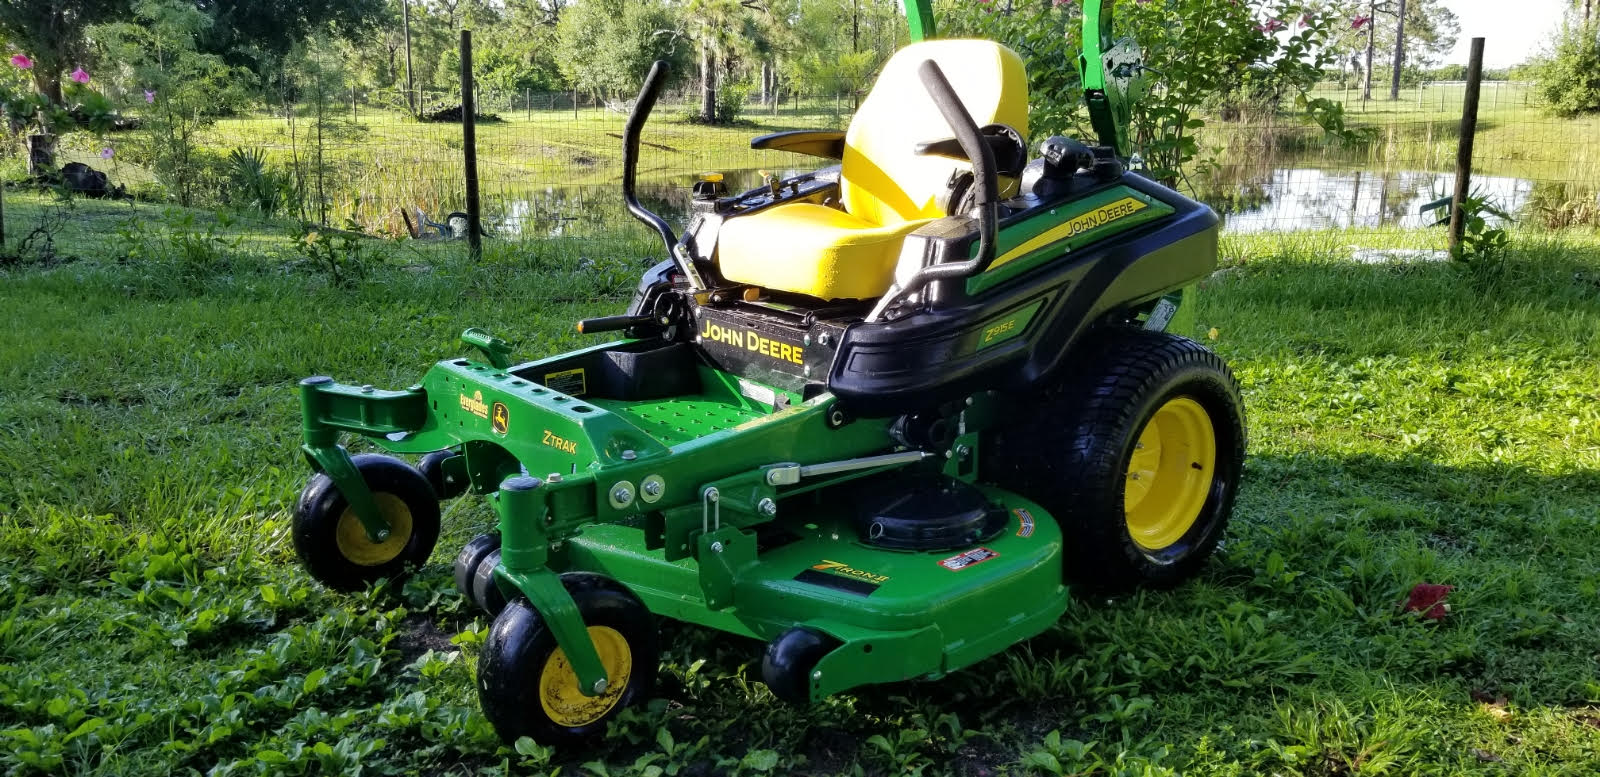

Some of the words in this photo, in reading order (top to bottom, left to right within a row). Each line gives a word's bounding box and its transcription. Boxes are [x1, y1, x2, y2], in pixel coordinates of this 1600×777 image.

[1067, 215, 1098, 236] JOHN
[1098, 201, 1134, 222] DEERE
[702, 320, 743, 348] JOHN
[747, 331, 804, 364] DEERE
[985, 319, 1016, 342] Z915E
[543, 430, 577, 454] ZTRAK
